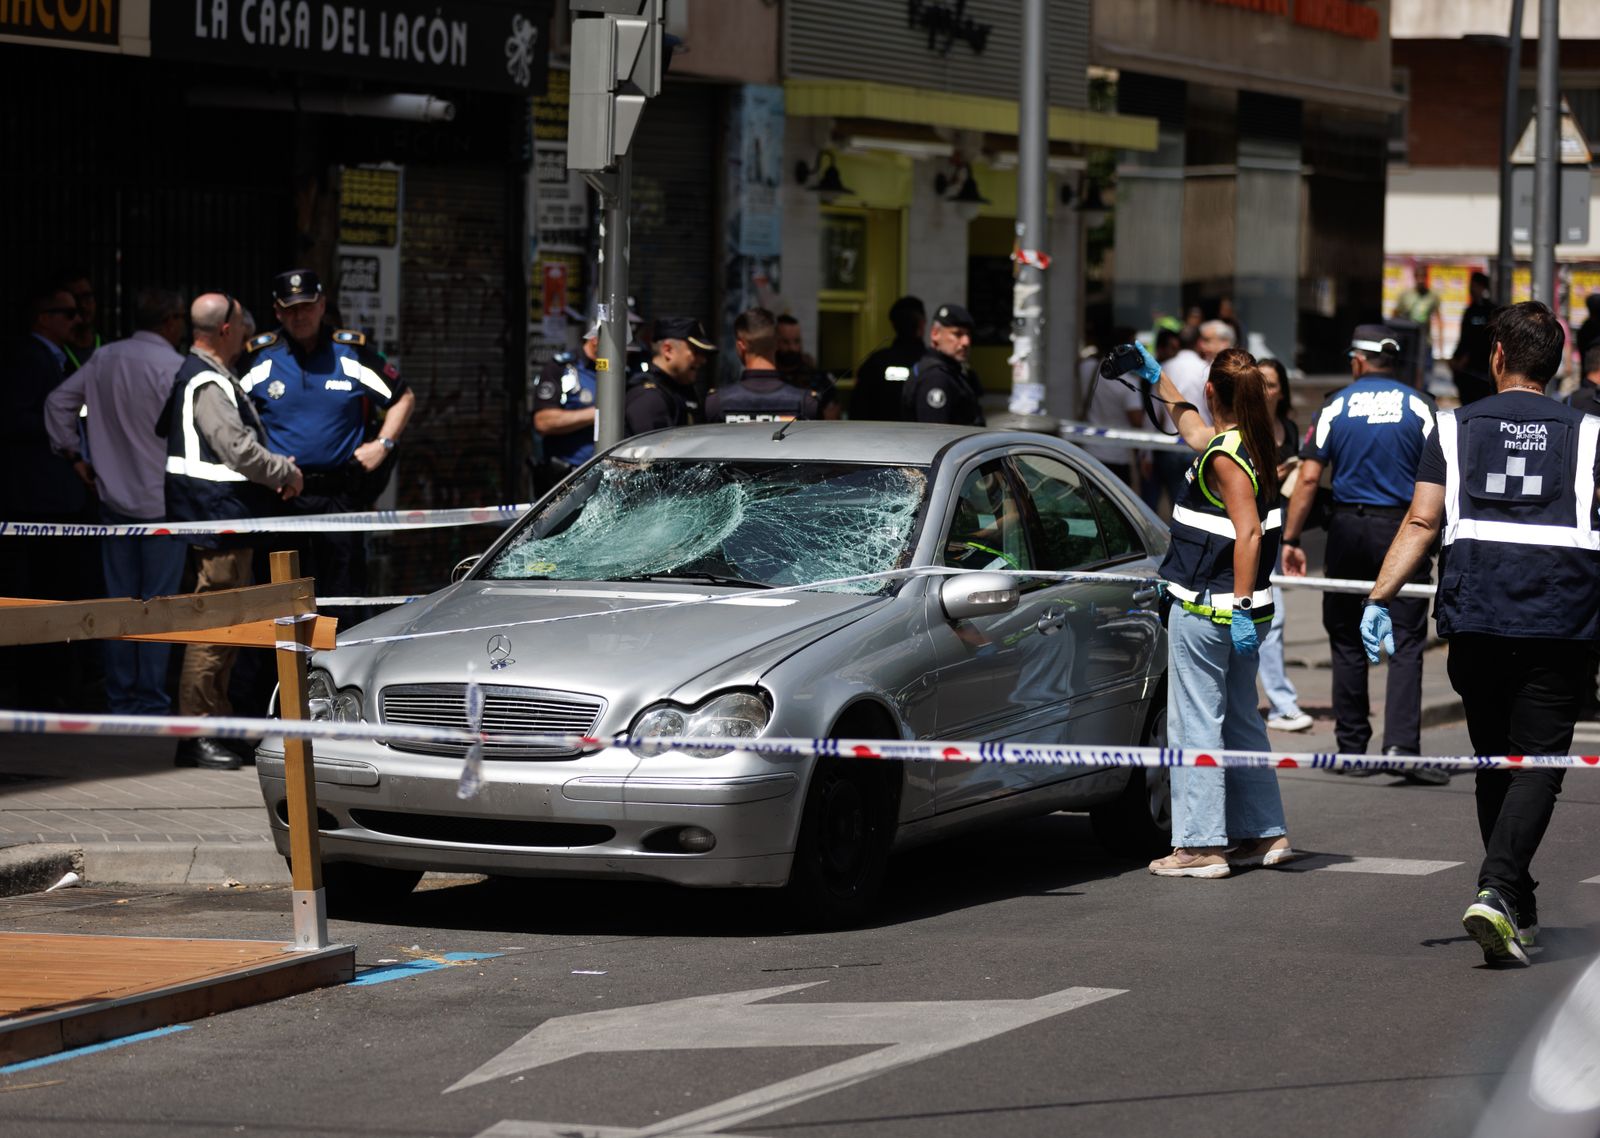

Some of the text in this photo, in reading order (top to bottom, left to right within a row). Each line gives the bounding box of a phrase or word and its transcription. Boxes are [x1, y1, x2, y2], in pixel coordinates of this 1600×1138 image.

[195, 0, 469, 67] LA CASA DEL LACÓN
[1499, 421, 1548, 435] POLICIA
[1504, 438, 1547, 451] madrid
